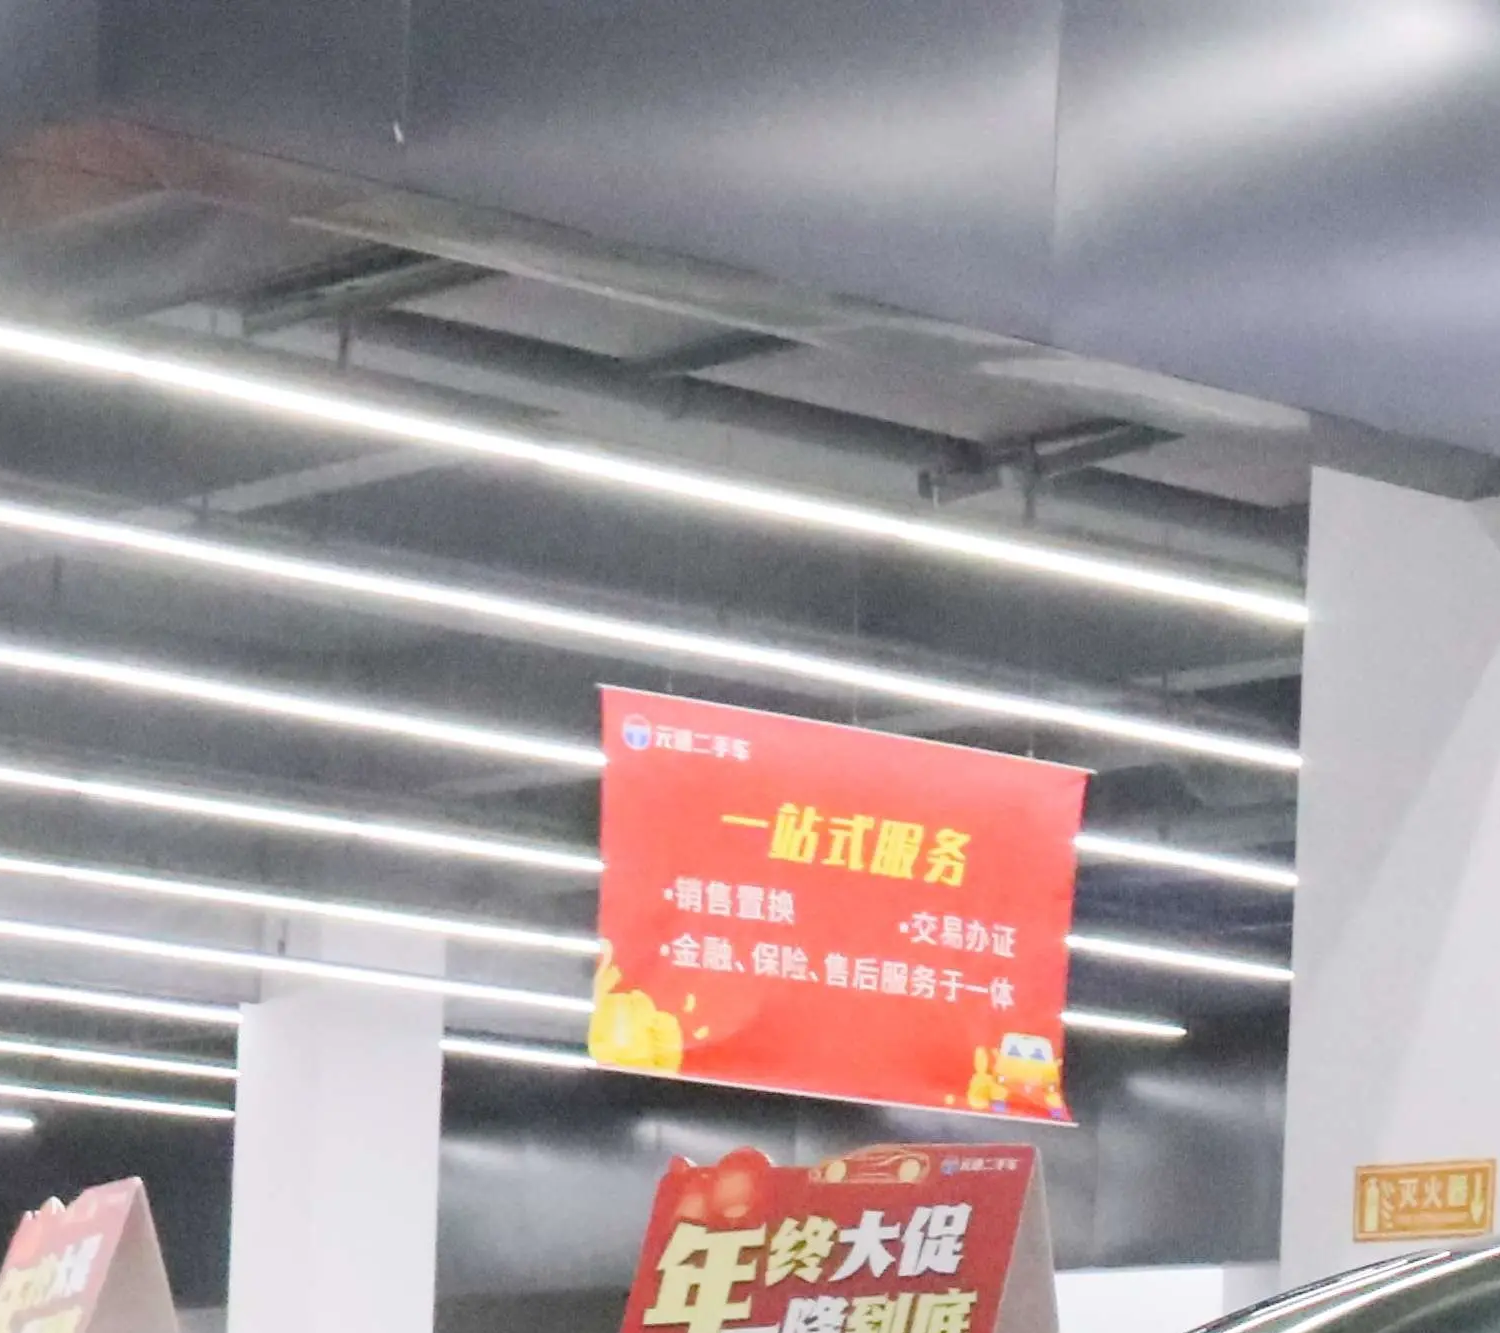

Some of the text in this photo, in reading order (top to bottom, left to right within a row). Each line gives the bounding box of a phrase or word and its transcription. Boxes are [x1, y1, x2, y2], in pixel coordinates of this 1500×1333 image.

[720, 802, 971, 887] 一站式服务
[674, 876, 1018, 959] 销售置换 交易办证
[670, 932, 1015, 1010] 金融、保险、售后服务于一体
